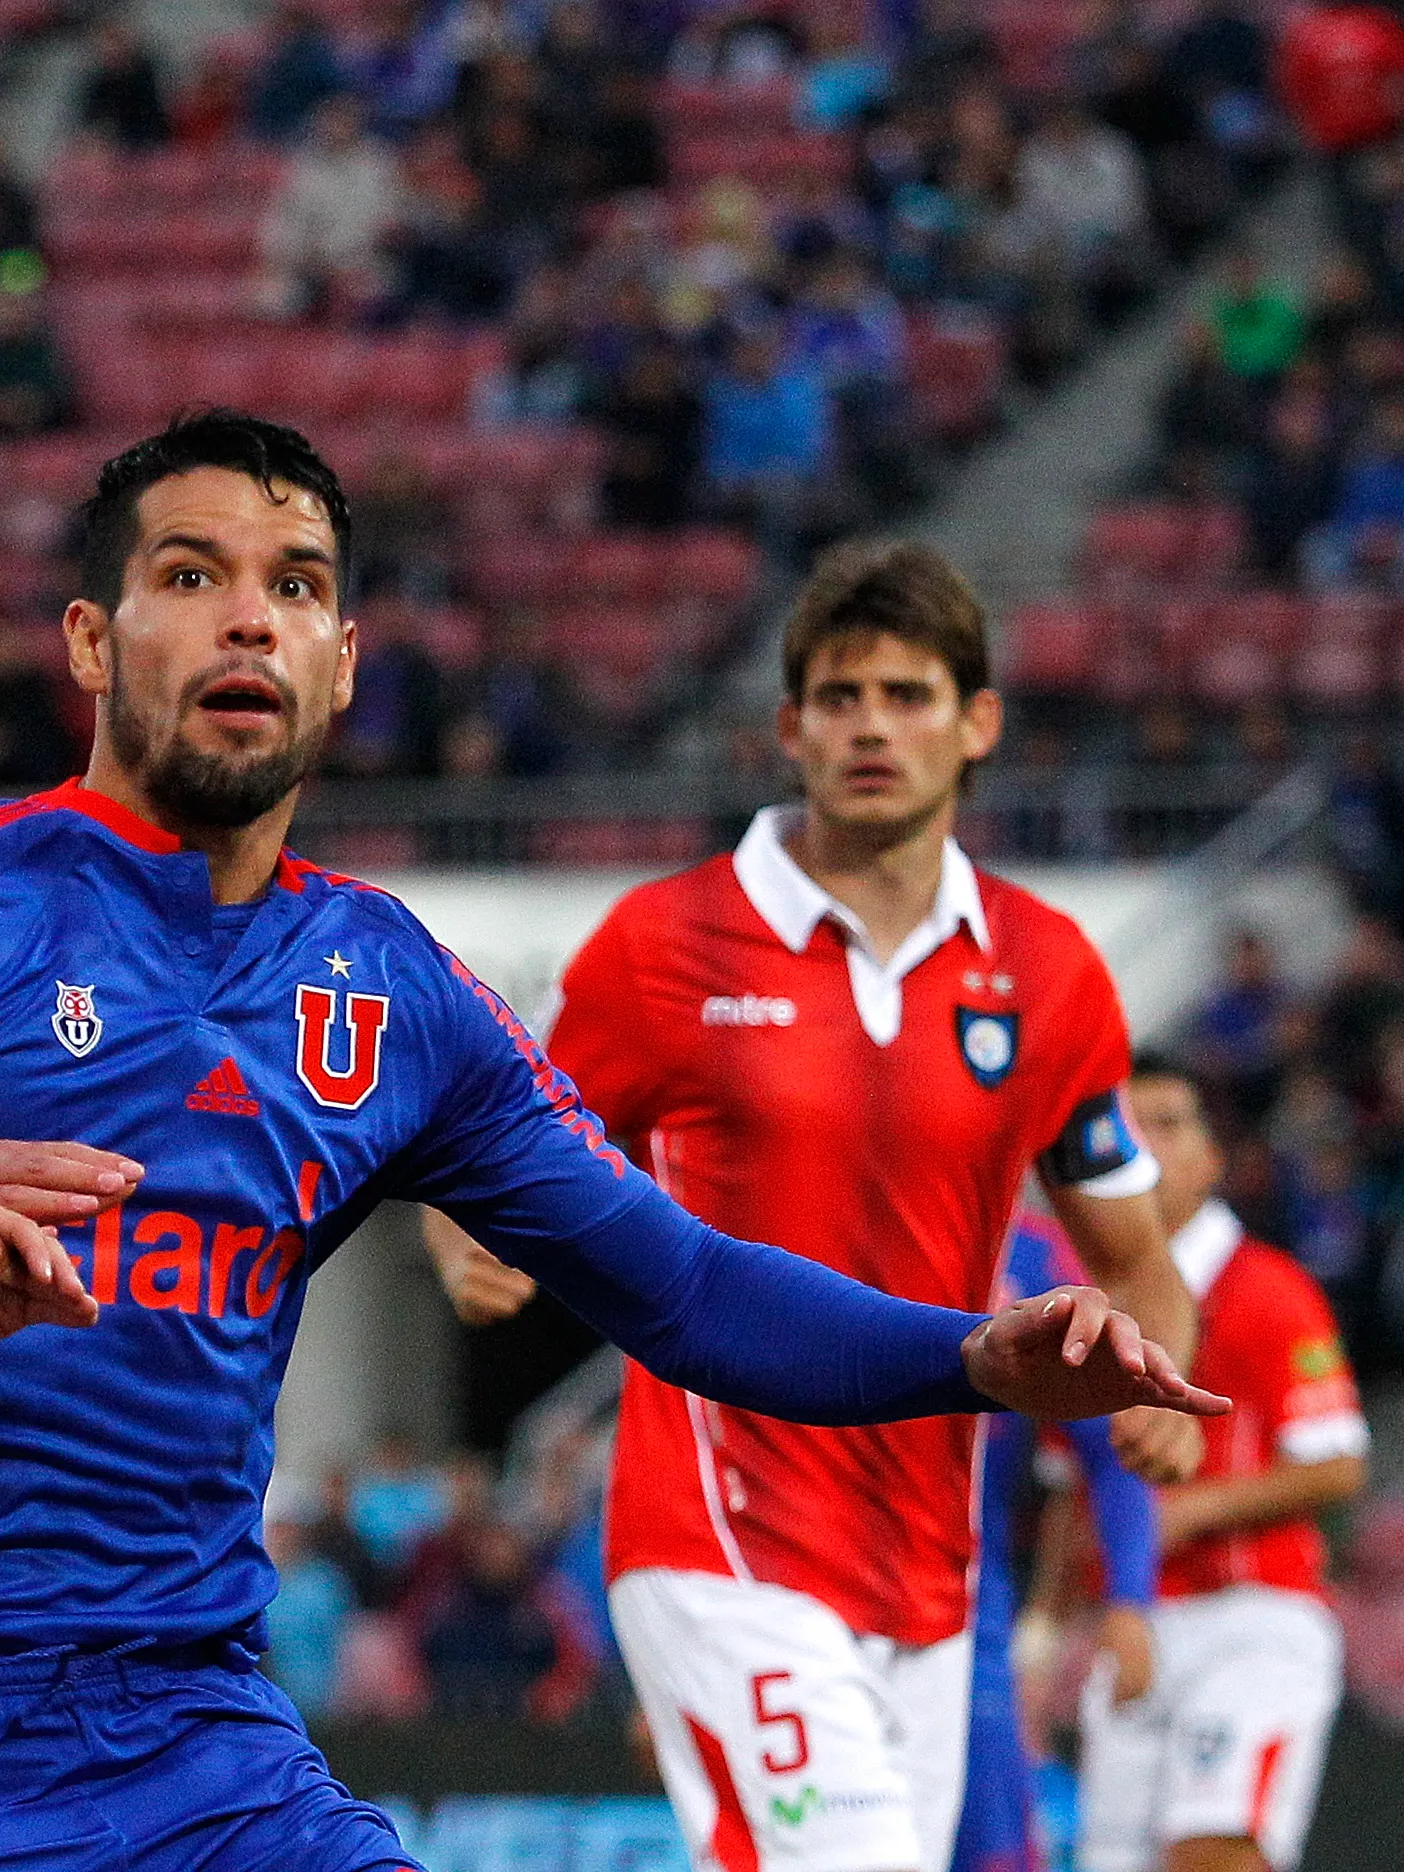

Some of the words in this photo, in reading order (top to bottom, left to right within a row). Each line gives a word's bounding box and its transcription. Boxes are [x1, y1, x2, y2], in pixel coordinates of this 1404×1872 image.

[65, 1019, 90, 1046] U
[294, 983, 391, 1110] U
[184, 1093, 260, 1118] adidas
[64, 1203, 306, 1319] laro
[749, 1670, 810, 1777] 5
